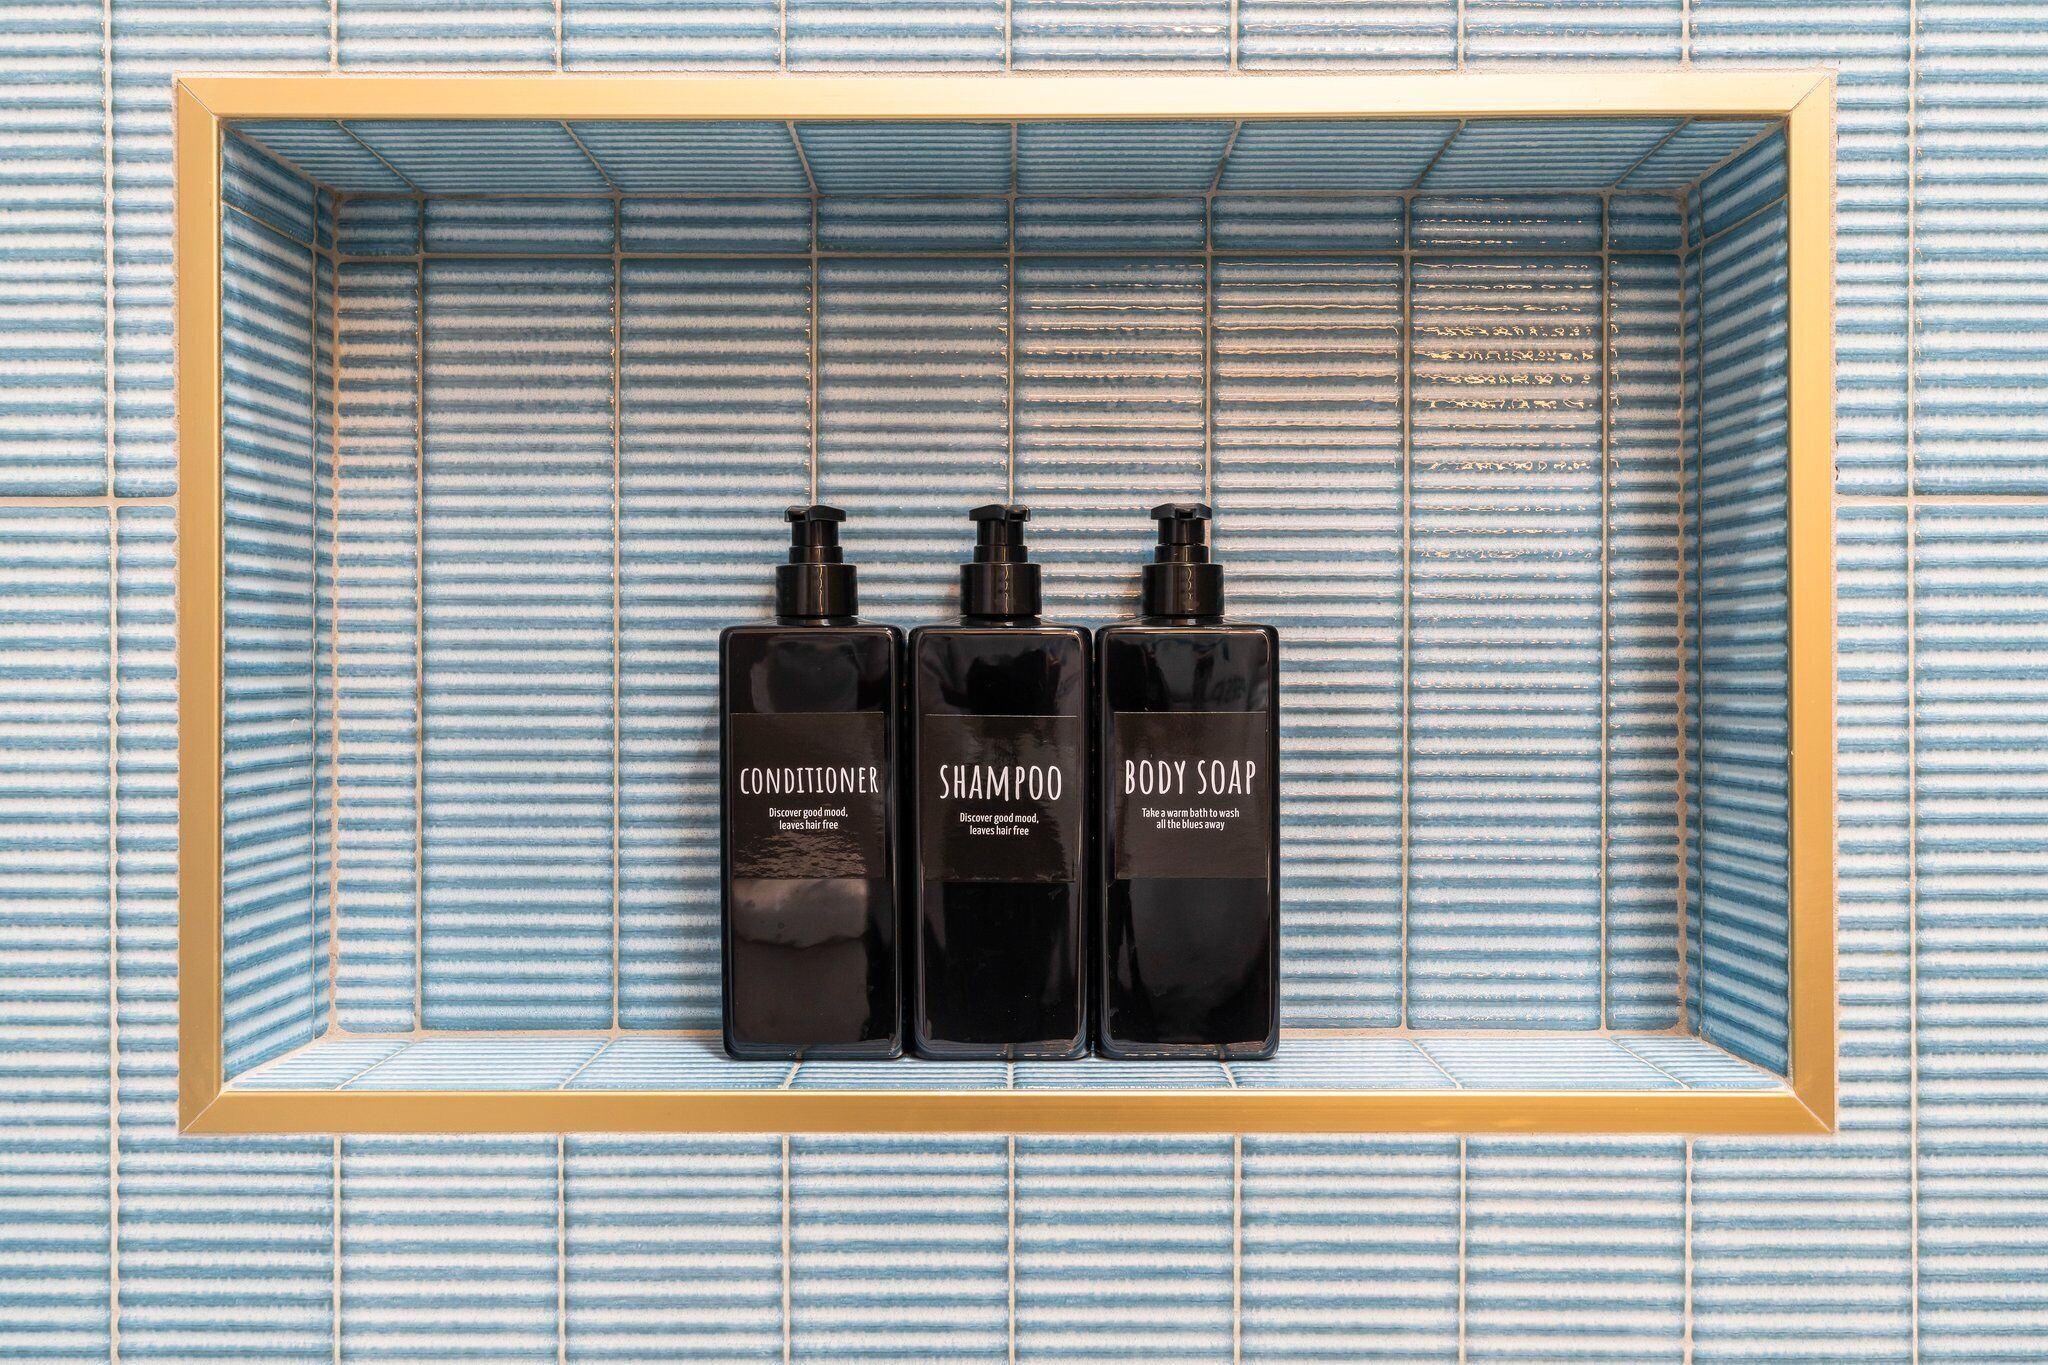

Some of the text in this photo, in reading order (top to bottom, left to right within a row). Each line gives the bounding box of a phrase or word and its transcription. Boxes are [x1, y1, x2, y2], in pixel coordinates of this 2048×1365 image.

[740, 766, 879, 795] CONDITIONER
[939, 764, 1062, 802] SHAMPOO
[1125, 759, 1256, 796] BODY SOAP
[769, 807, 848, 820] Discover good mood,
[960, 813, 1039, 825] Discover good mood,
[1141, 807, 1240, 818] Take a warm bath to wash
[779, 819, 839, 830] leaves hair free
[969, 825, 1030, 836] leaves hair free
[1156, 818, 1225, 831] all the blues away
